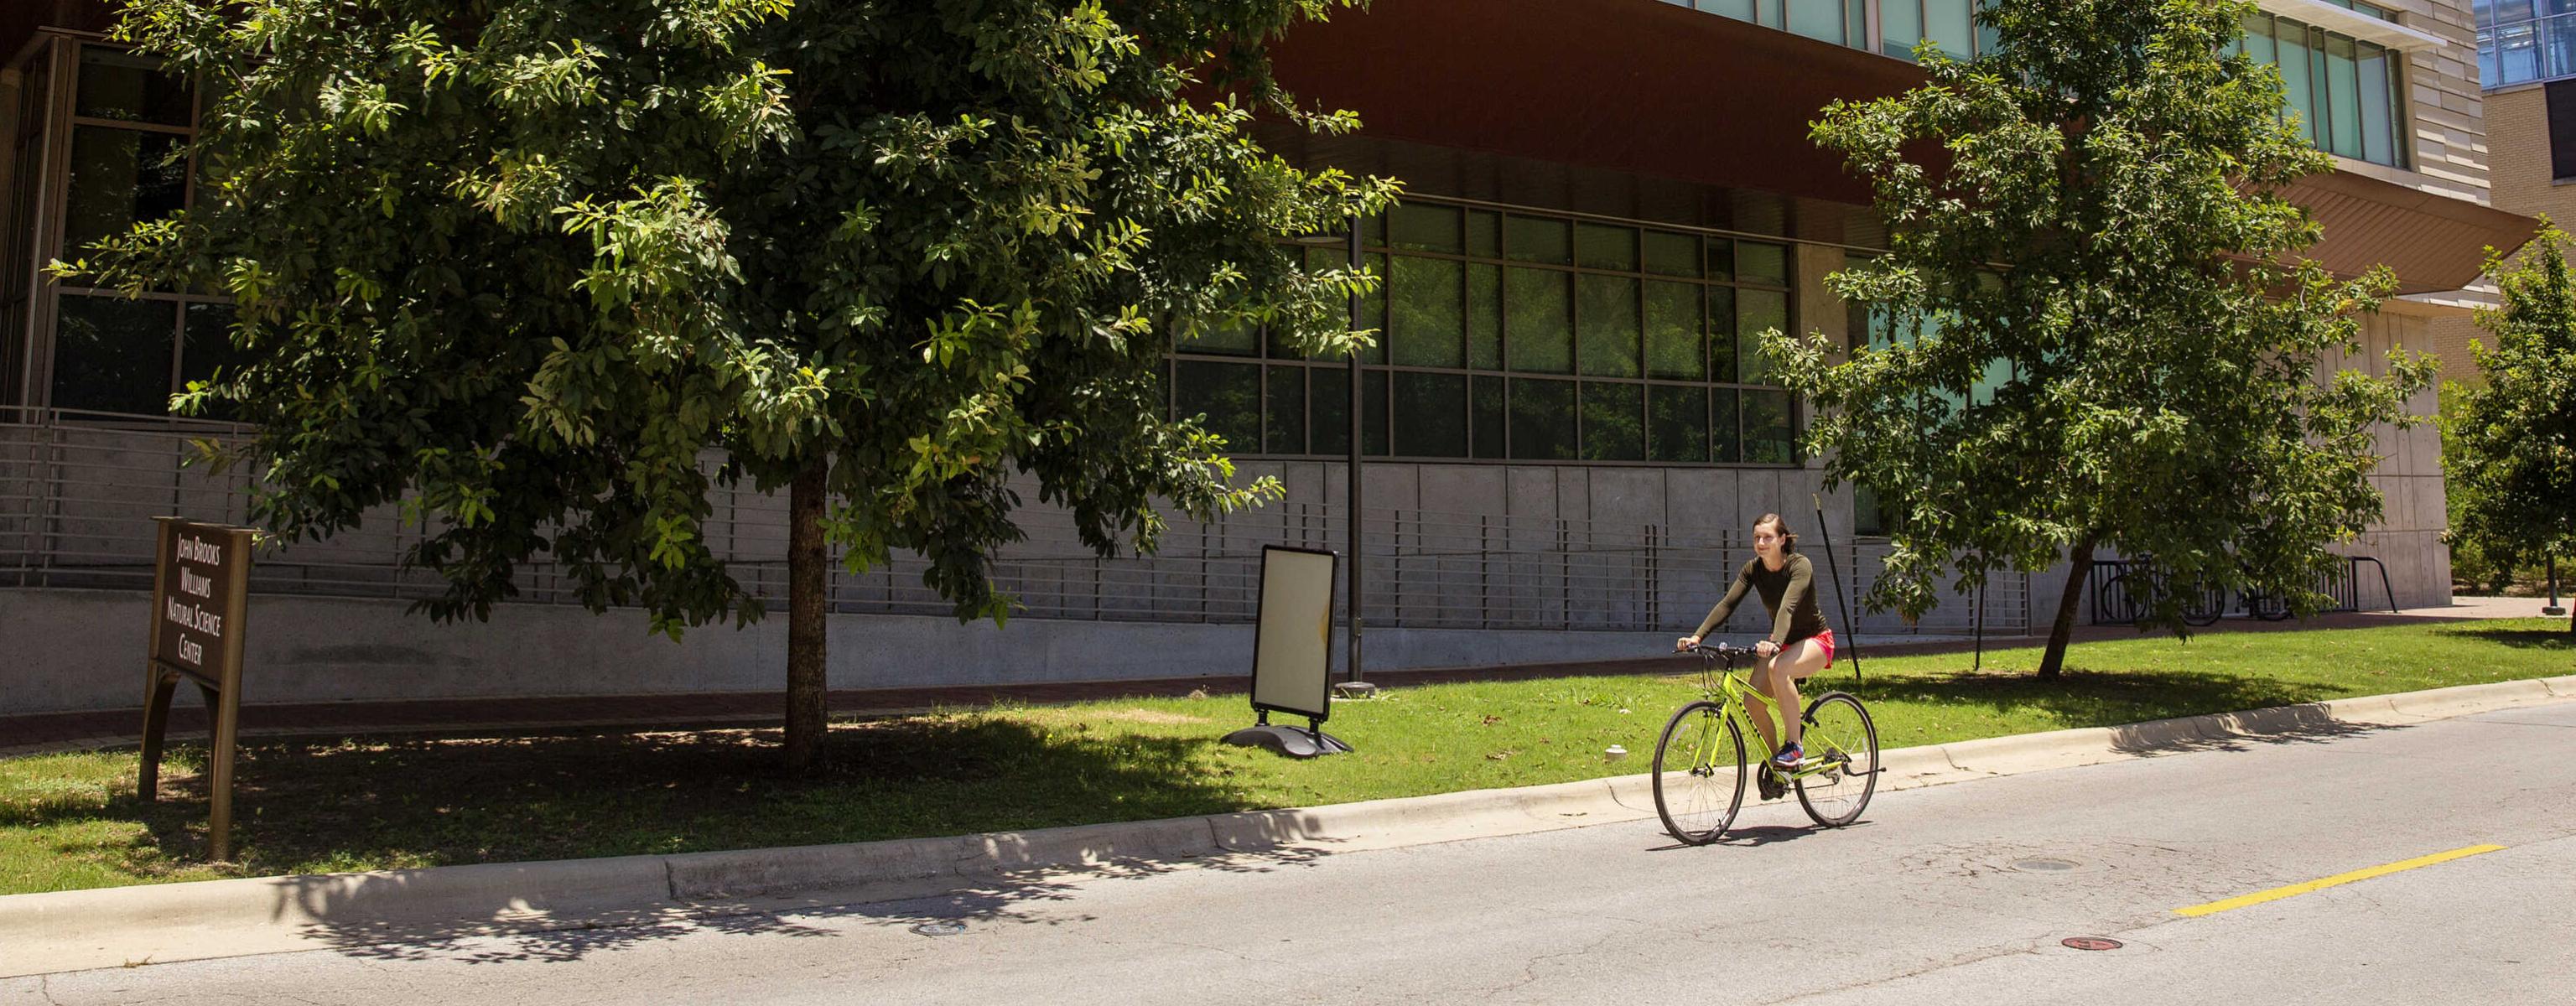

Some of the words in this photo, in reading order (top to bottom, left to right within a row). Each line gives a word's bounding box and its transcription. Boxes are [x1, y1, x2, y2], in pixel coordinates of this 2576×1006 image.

[176, 532, 194, 563] JOHN
[194, 536, 221, 566] BROOKS
[181, 566, 210, 599] WILLIAMS
[168, 595, 193, 628] NATURAL
[194, 604, 221, 637] SCIENCE
[179, 633, 202, 665] CENTER
